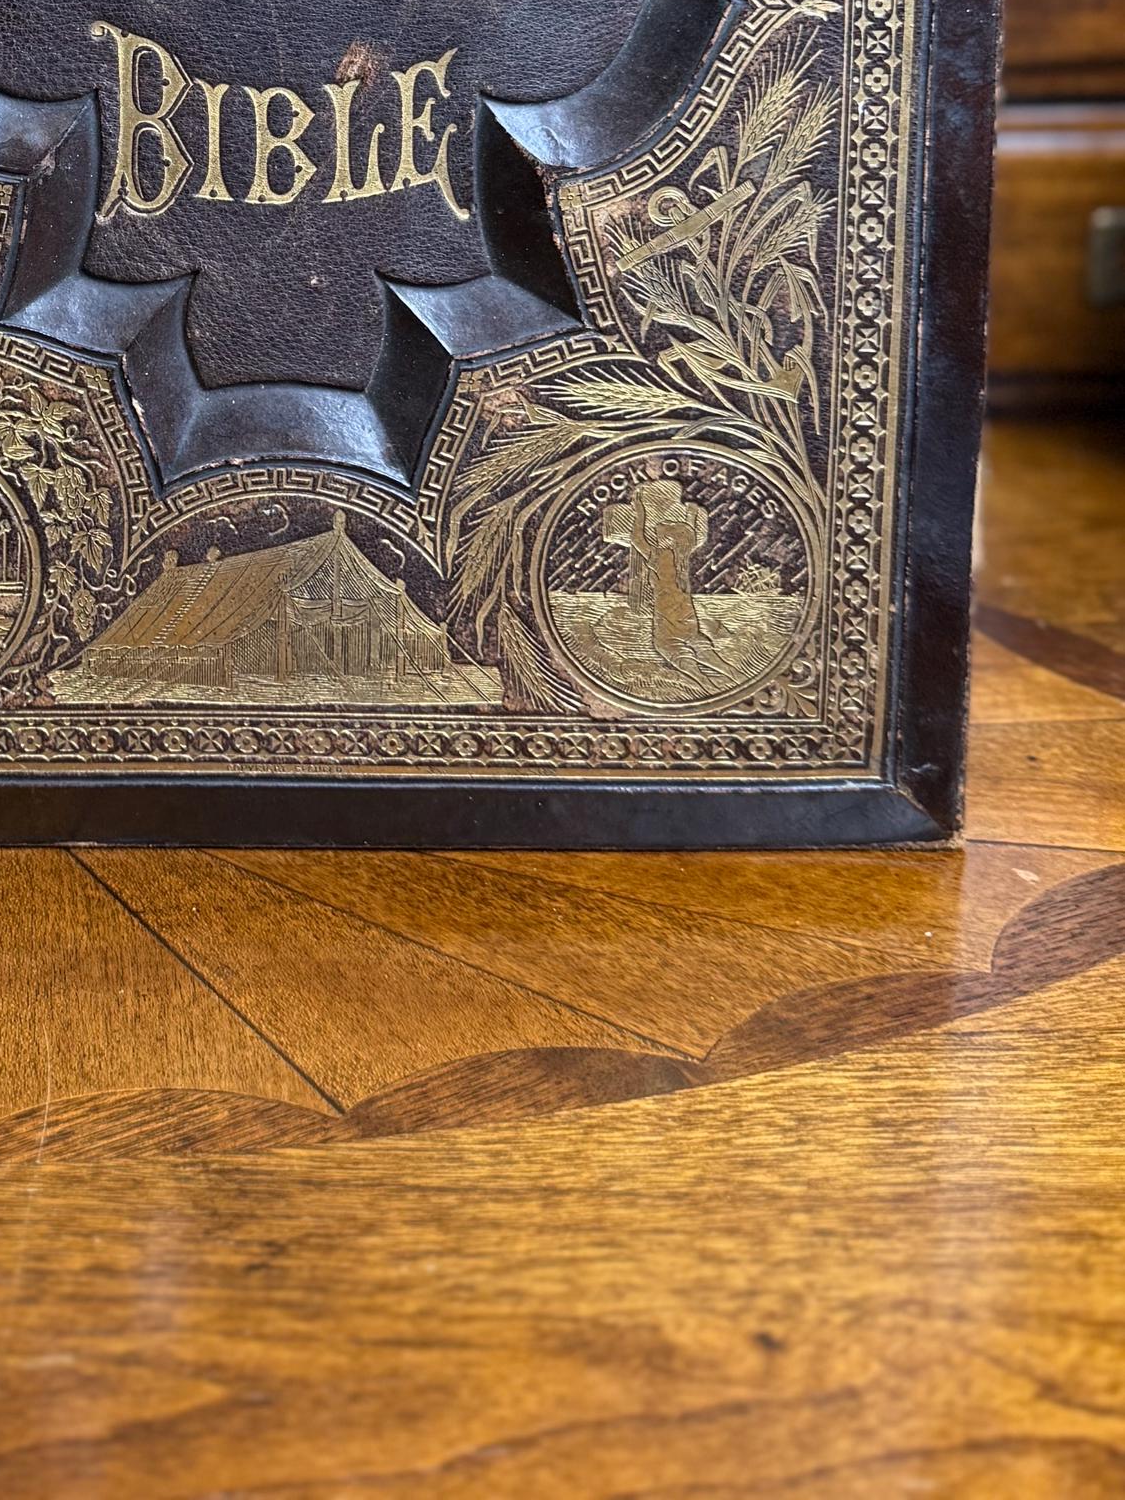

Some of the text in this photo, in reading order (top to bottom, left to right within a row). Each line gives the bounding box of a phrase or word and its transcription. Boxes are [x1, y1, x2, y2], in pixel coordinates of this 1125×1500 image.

[89, 19, 471, 225] BIBLE
[576, 457, 780, 520] ROCK OF AGES
